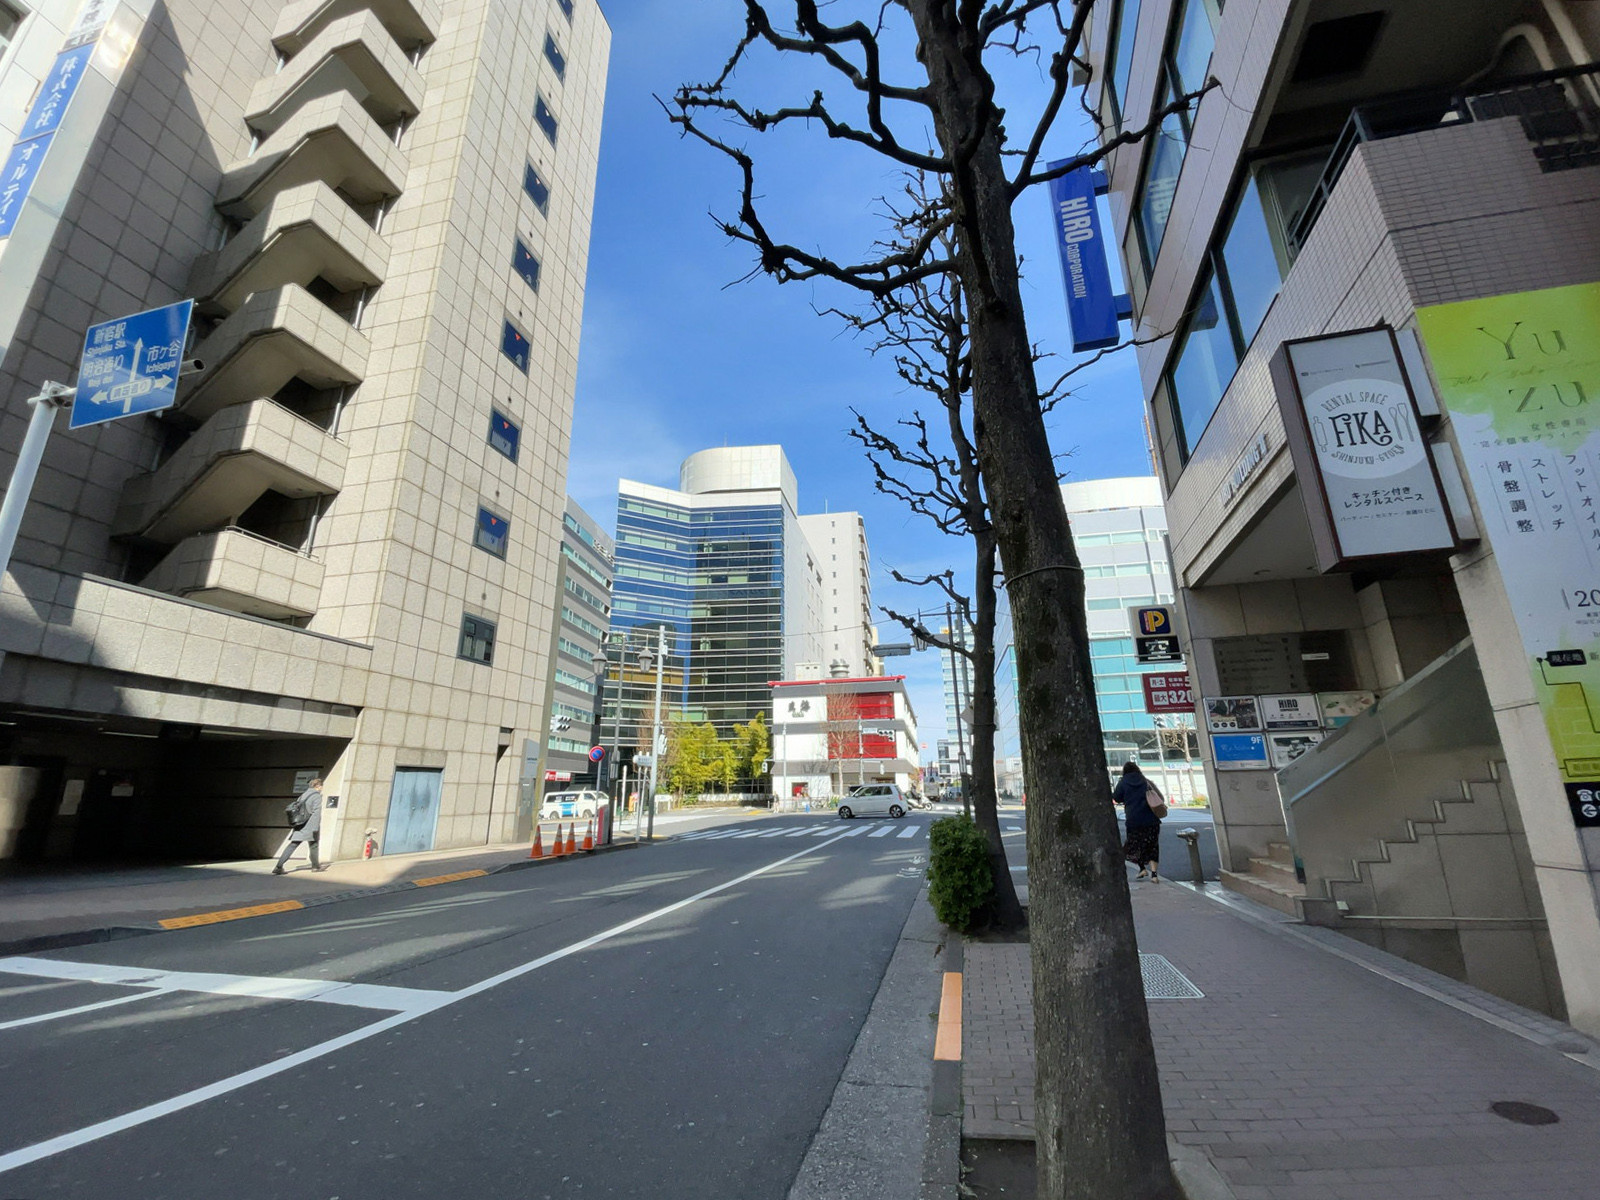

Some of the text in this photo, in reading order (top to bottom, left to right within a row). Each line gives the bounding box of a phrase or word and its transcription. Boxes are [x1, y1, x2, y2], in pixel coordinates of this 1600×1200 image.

[1060, 196, 1094, 299] HIRO CORPORATION
[146, 360, 177, 374] Ichigaya
[1321, 391, 1388, 412] RENTAL SPACE
[1344, 493, 1424, 508] レンタルスペース
[1352, 486, 1410, 500] キッチン付き
[1497, 460, 1535, 533] 骨盤調整
[1532, 458, 1565, 531] ストレッチ
[1250, 736, 1262, 745] 9F
